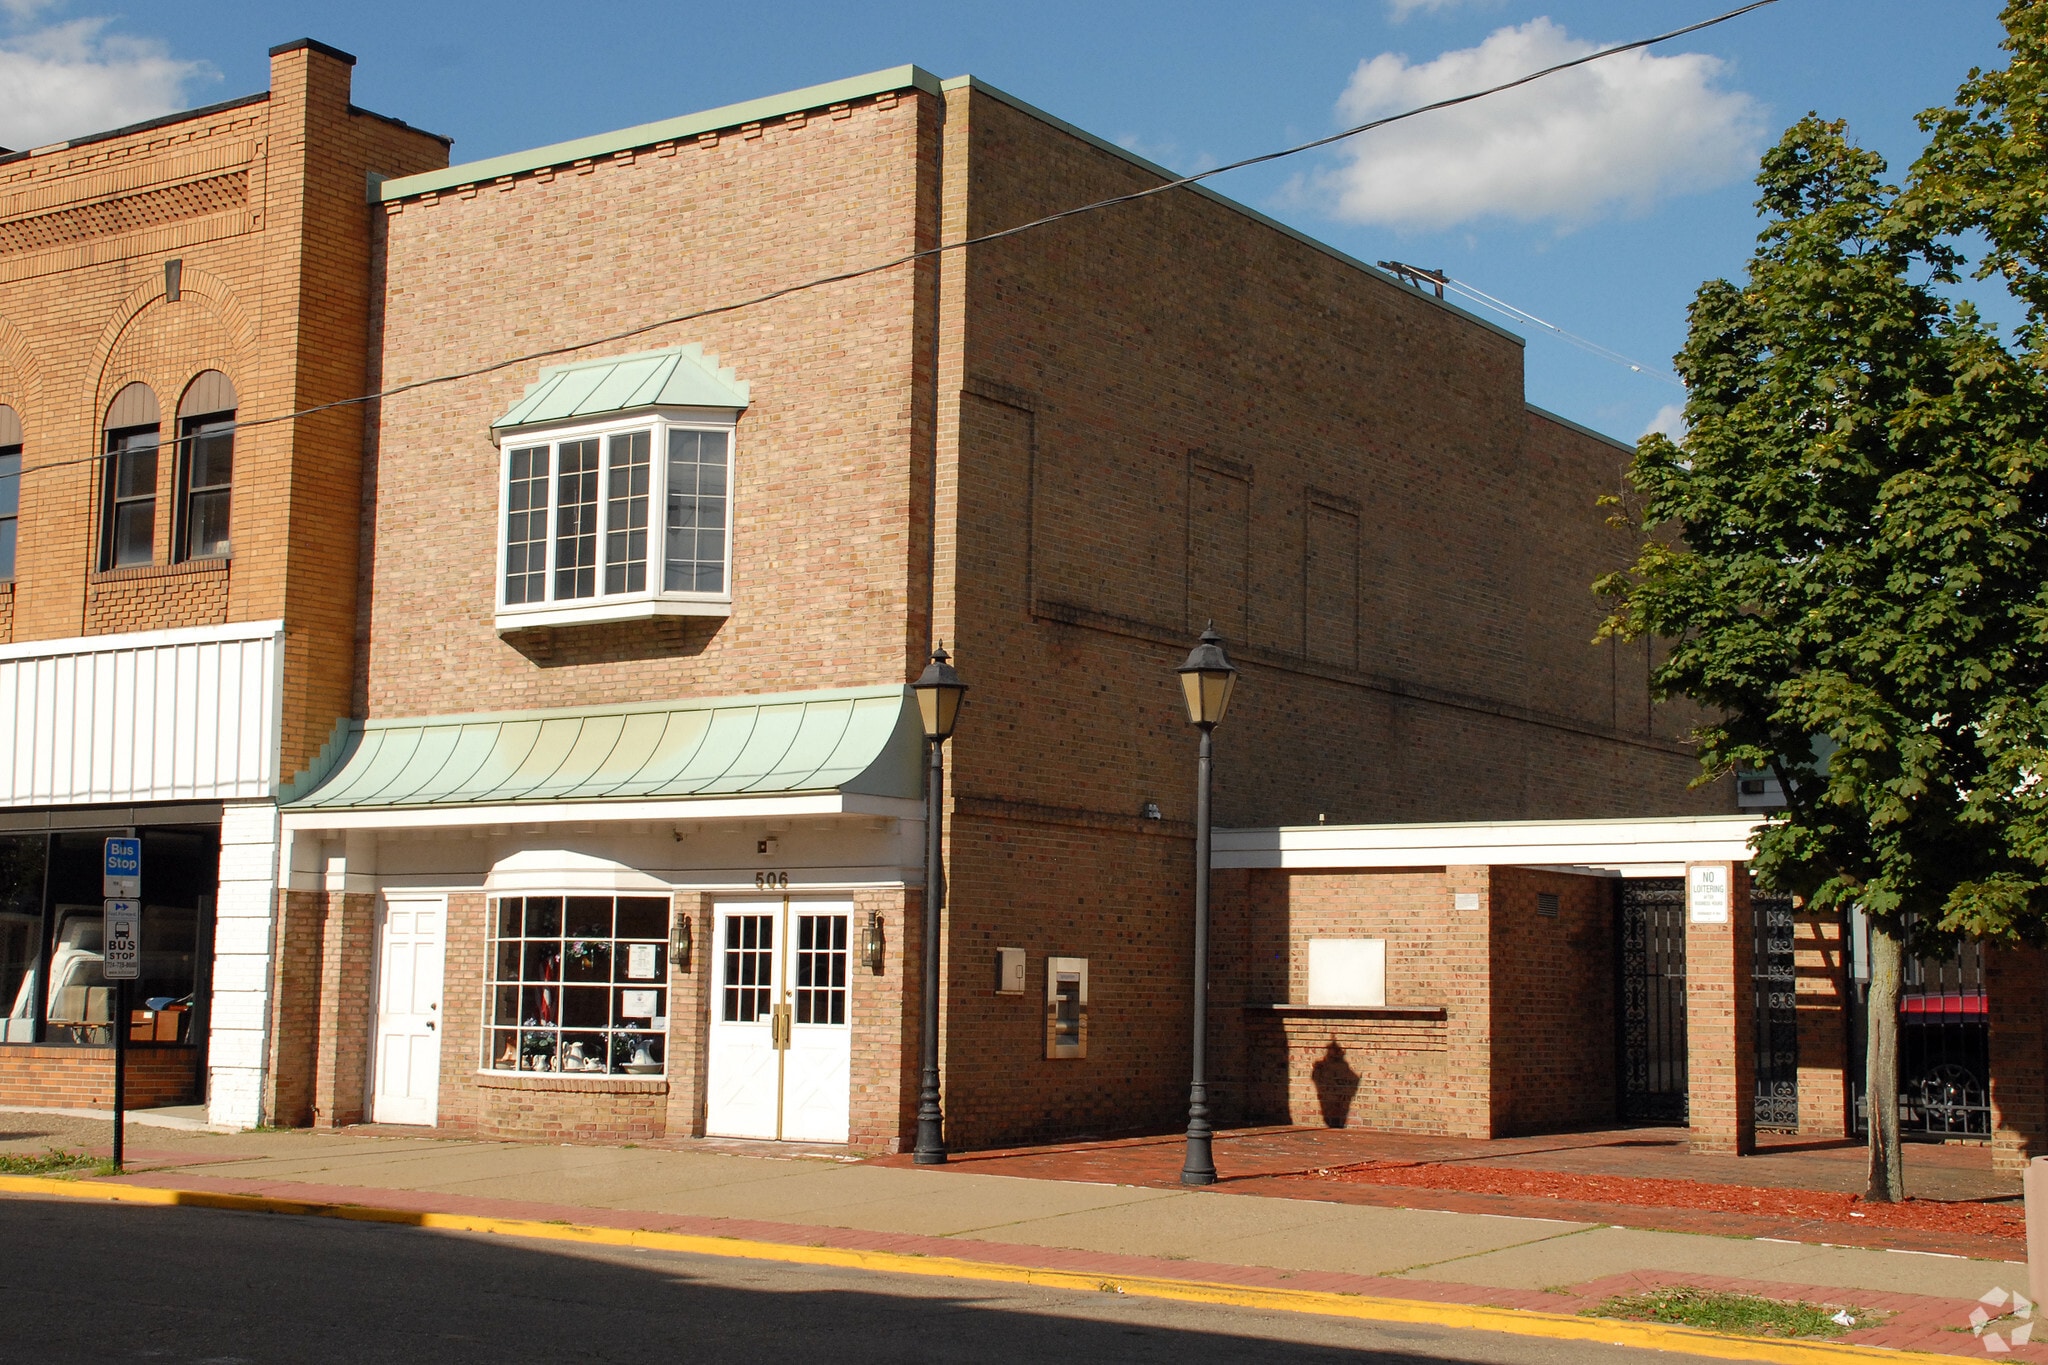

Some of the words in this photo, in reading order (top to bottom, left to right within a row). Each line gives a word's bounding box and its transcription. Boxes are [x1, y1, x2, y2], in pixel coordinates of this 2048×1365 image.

[111, 843, 134, 855] Bus
[108, 856, 137, 871] Stop
[755, 871, 788, 889] 506
[1702, 871, 1715, 883] NO
[1693, 884, 1724, 893] LOITERING
[109, 940, 136, 951] BUS
[109, 952, 135, 960] STOP
